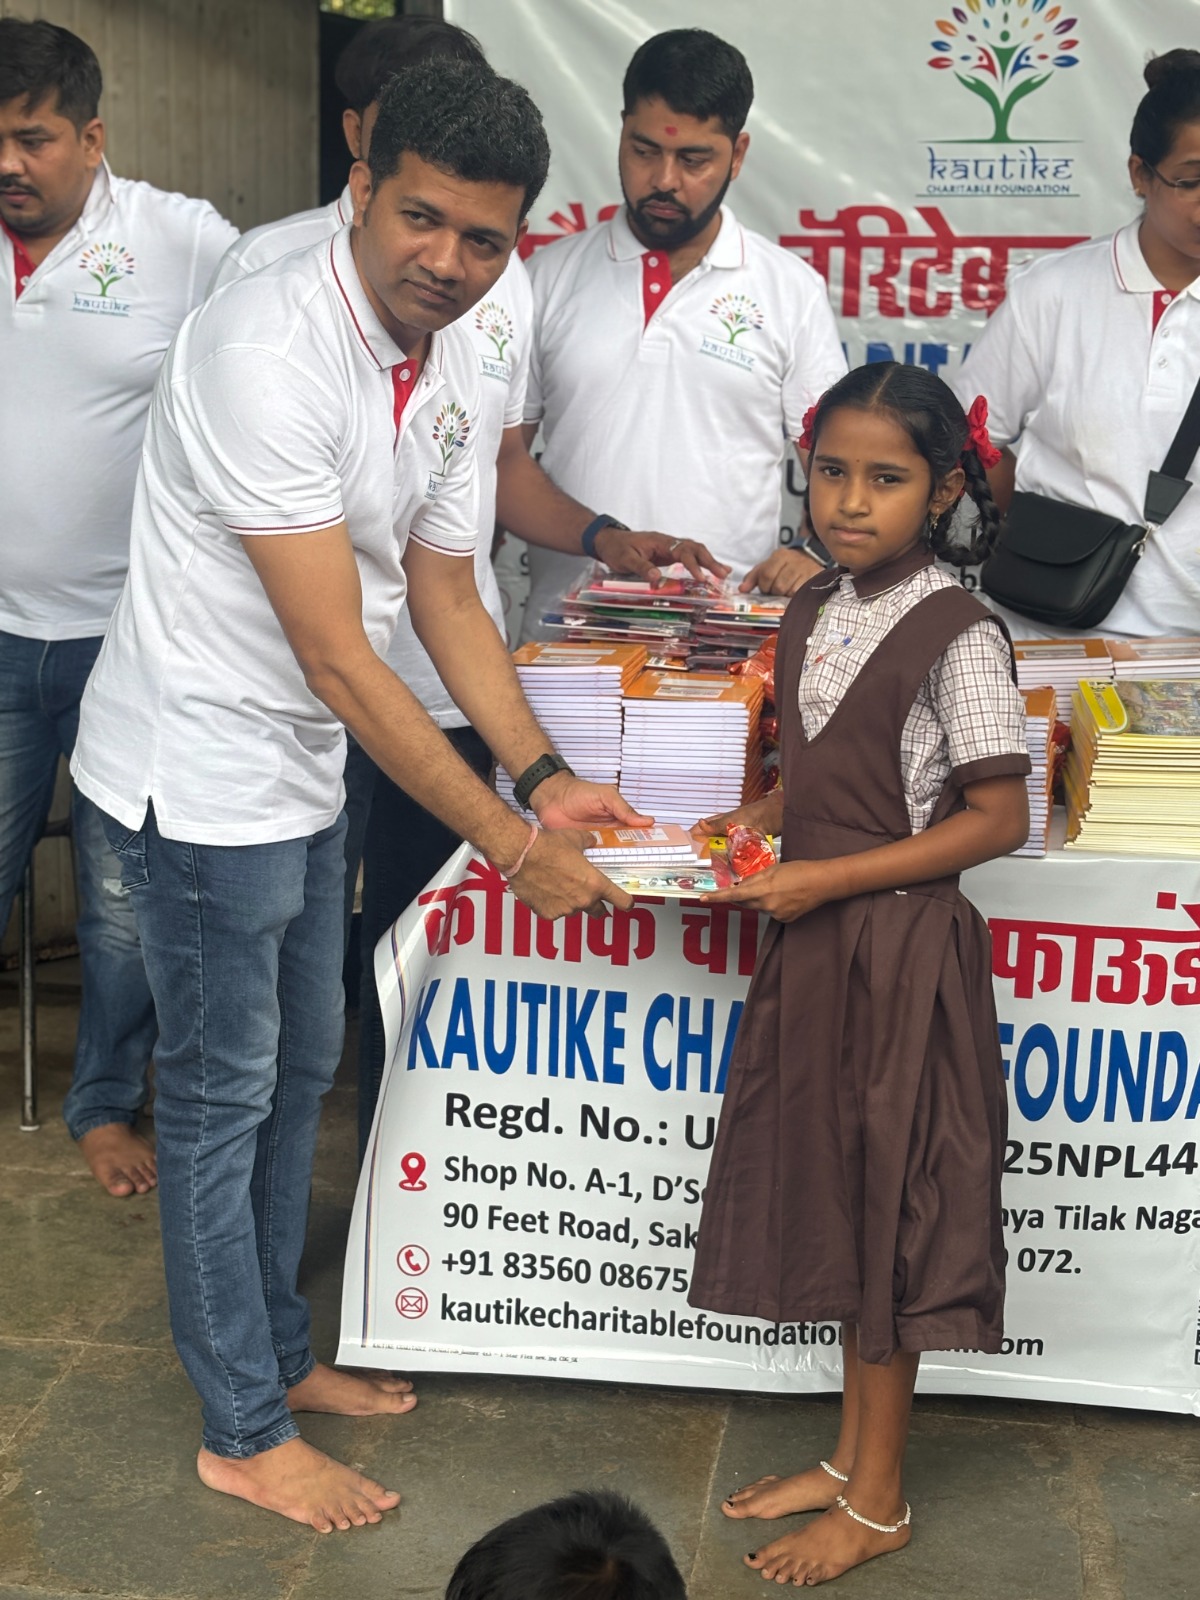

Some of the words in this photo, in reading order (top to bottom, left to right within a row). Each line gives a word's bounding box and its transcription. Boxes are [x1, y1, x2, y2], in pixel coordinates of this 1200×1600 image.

[927, 146, 1075, 180] kautike
[926, 184, 991, 194] CHARITABLE
[994, 184, 1070, 194] FOUNDATION
[406, 977, 628, 1085] KAUTIKE
[997, 1022, 1200, 1123] OUND
[445, 1092, 563, 1139] Regd.
[580, 1103, 668, 1146] No.:
[443, 1156, 517, 1190] Shop
[527, 1161, 576, 1191] No.
[585, 1168, 642, 1204] A-1,
[1054, 1205, 1127, 1231] Tilak
[443, 1202, 478, 1229] 90
[488, 1205, 549, 1235] Feet
[559, 1211, 640, 1250] Road,
[442, 1250, 493, 1277] +91
[502, 1252, 591, 1284] 83560
[600, 1260, 688, 1293] 08675
[1017, 1247, 1081, 1274] 072.
[441, 1293, 842, 1346] kautikecharitablefoundatio
